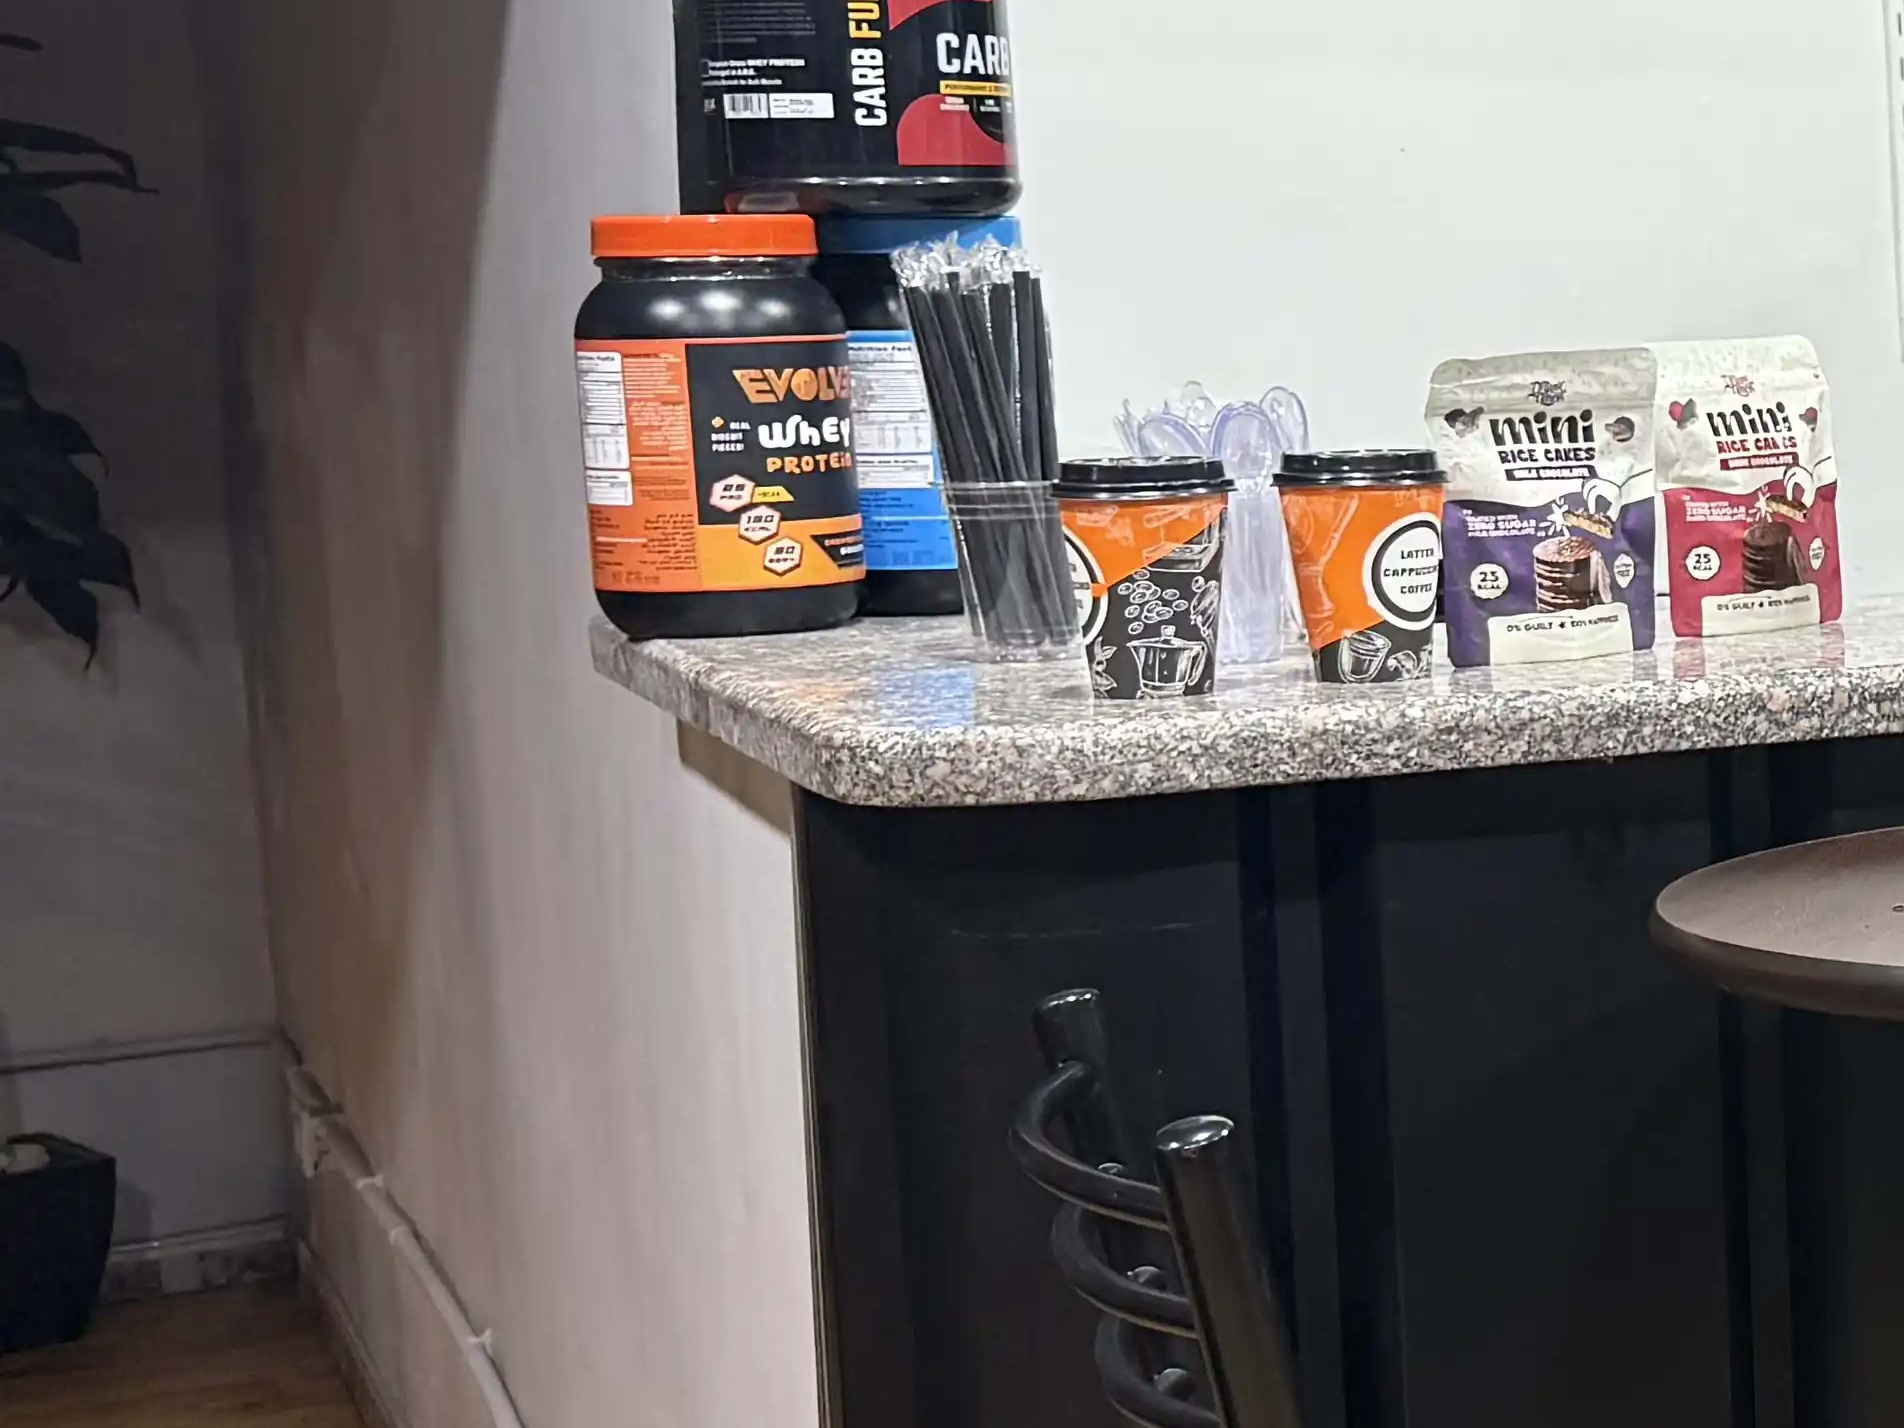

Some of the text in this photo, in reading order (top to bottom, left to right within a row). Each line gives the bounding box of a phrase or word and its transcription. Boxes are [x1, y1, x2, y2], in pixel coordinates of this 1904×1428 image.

[936, 32, 1009, 76] CARB
[851, 48, 887, 126] CARB
[1489, 409, 1595, 447] mini
[1705, 401, 1793, 437] mini
[1498, 447, 1596, 464] RICE CAKES
[1716, 439, 1751, 454] RICE
[1497, 520, 1537, 529] SUGAR
[1694, 553, 1712, 565] 25
